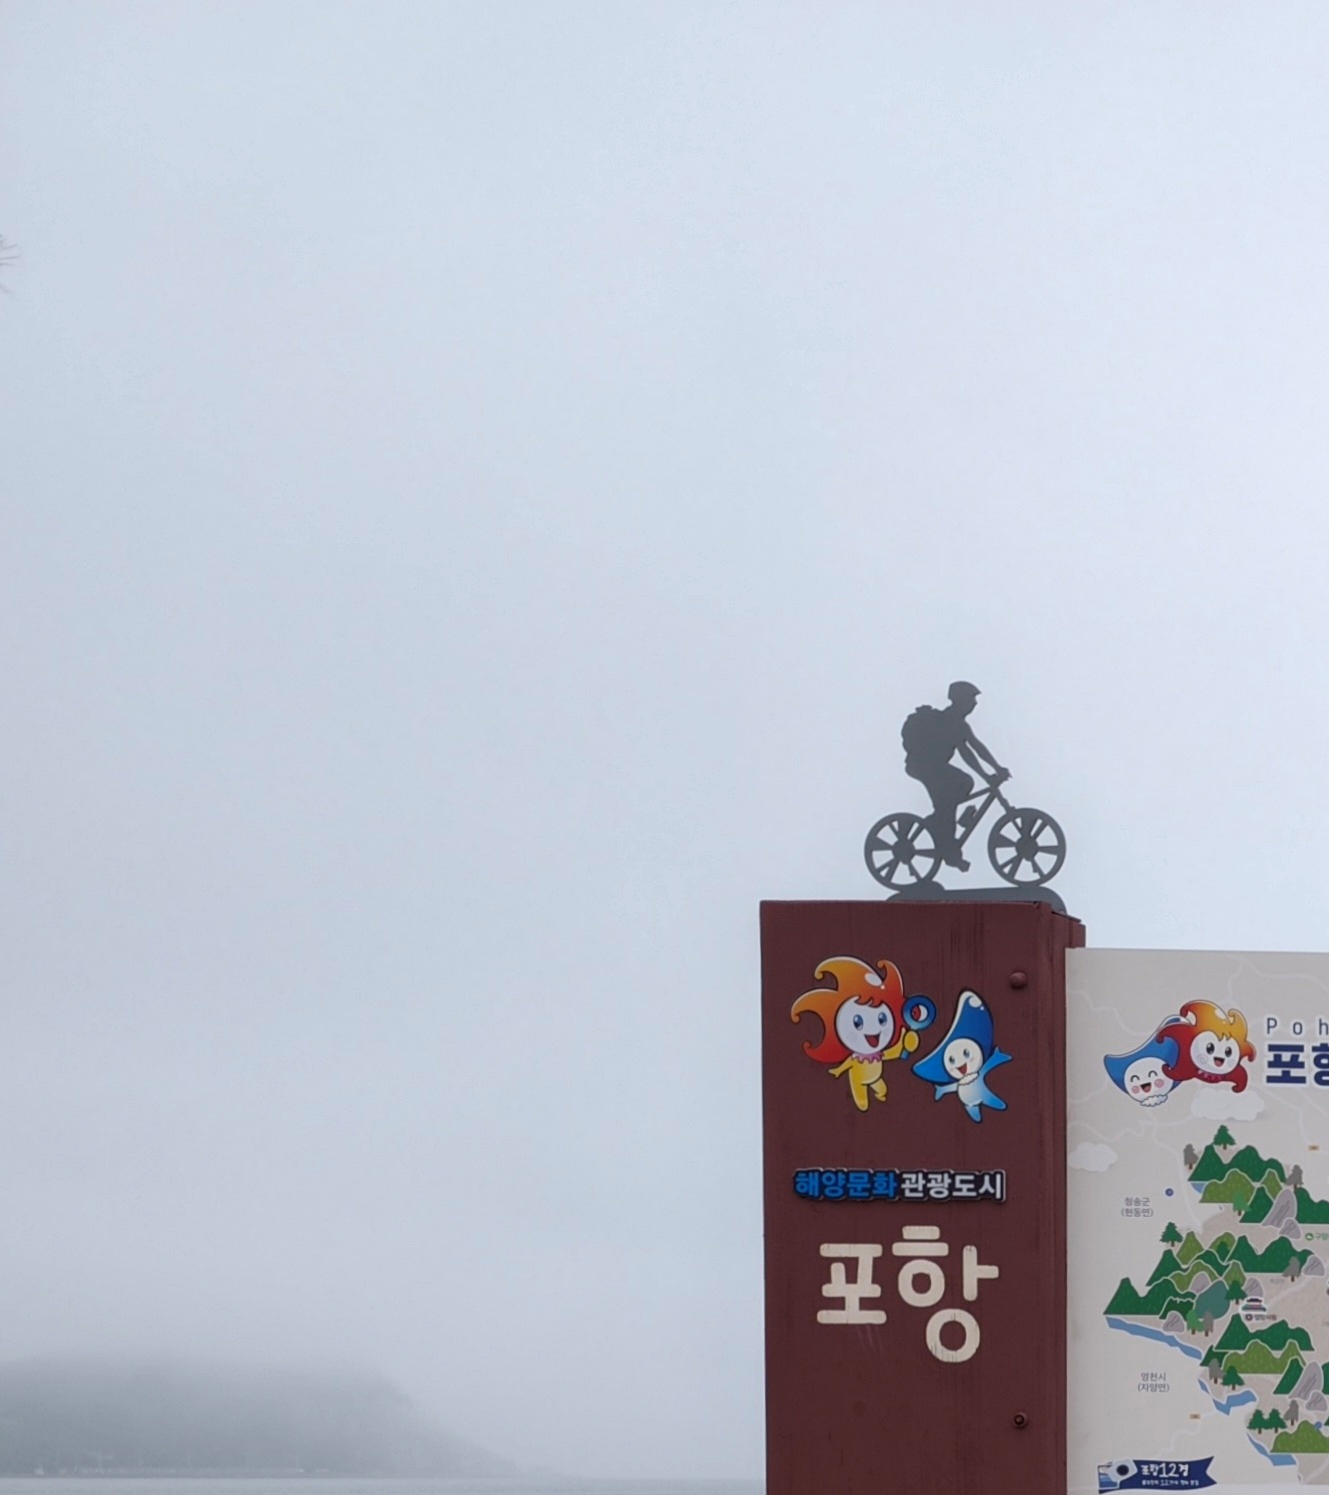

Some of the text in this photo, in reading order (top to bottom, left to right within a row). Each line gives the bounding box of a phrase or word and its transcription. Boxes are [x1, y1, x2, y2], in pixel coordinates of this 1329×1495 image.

[794, 1172, 1003, 1200] 해양문화 관광도시
[1124, 1196, 1150, 1207] 청송군
[1120, 1207, 1154, 1218] (현동면)
[816, 1225, 1000, 1364] 포항
[1140, 1371, 1167, 1382] 영천시
[1140, 1462, 1189, 1478] 포항12경
